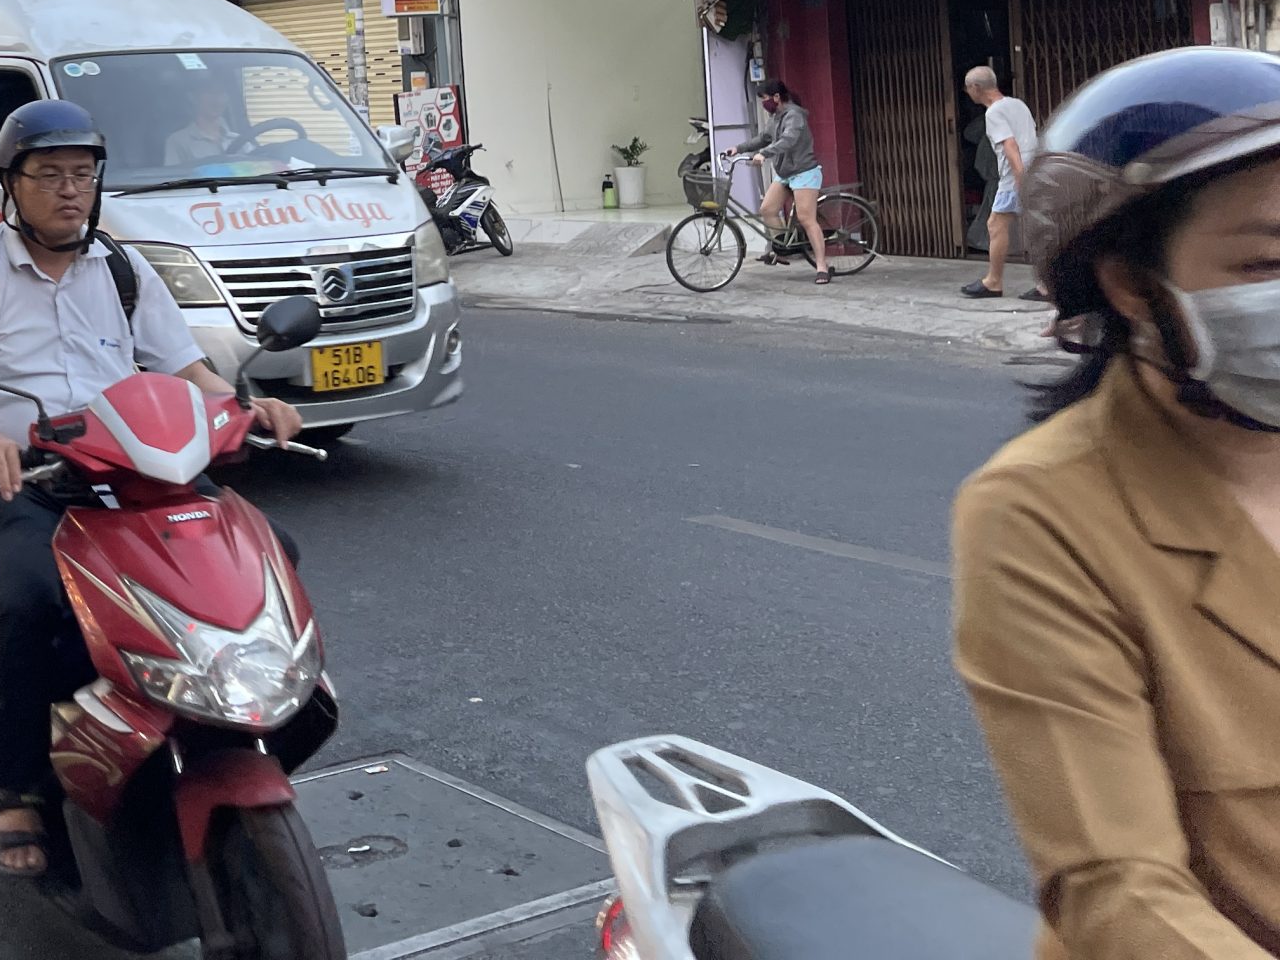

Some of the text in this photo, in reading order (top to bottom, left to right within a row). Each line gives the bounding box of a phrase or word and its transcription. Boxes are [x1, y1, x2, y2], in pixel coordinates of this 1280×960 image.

[189, 193, 394, 235] Tuấn Nga
[332, 346, 362, 366] 51B
[166, 510, 211, 523] HONDA
